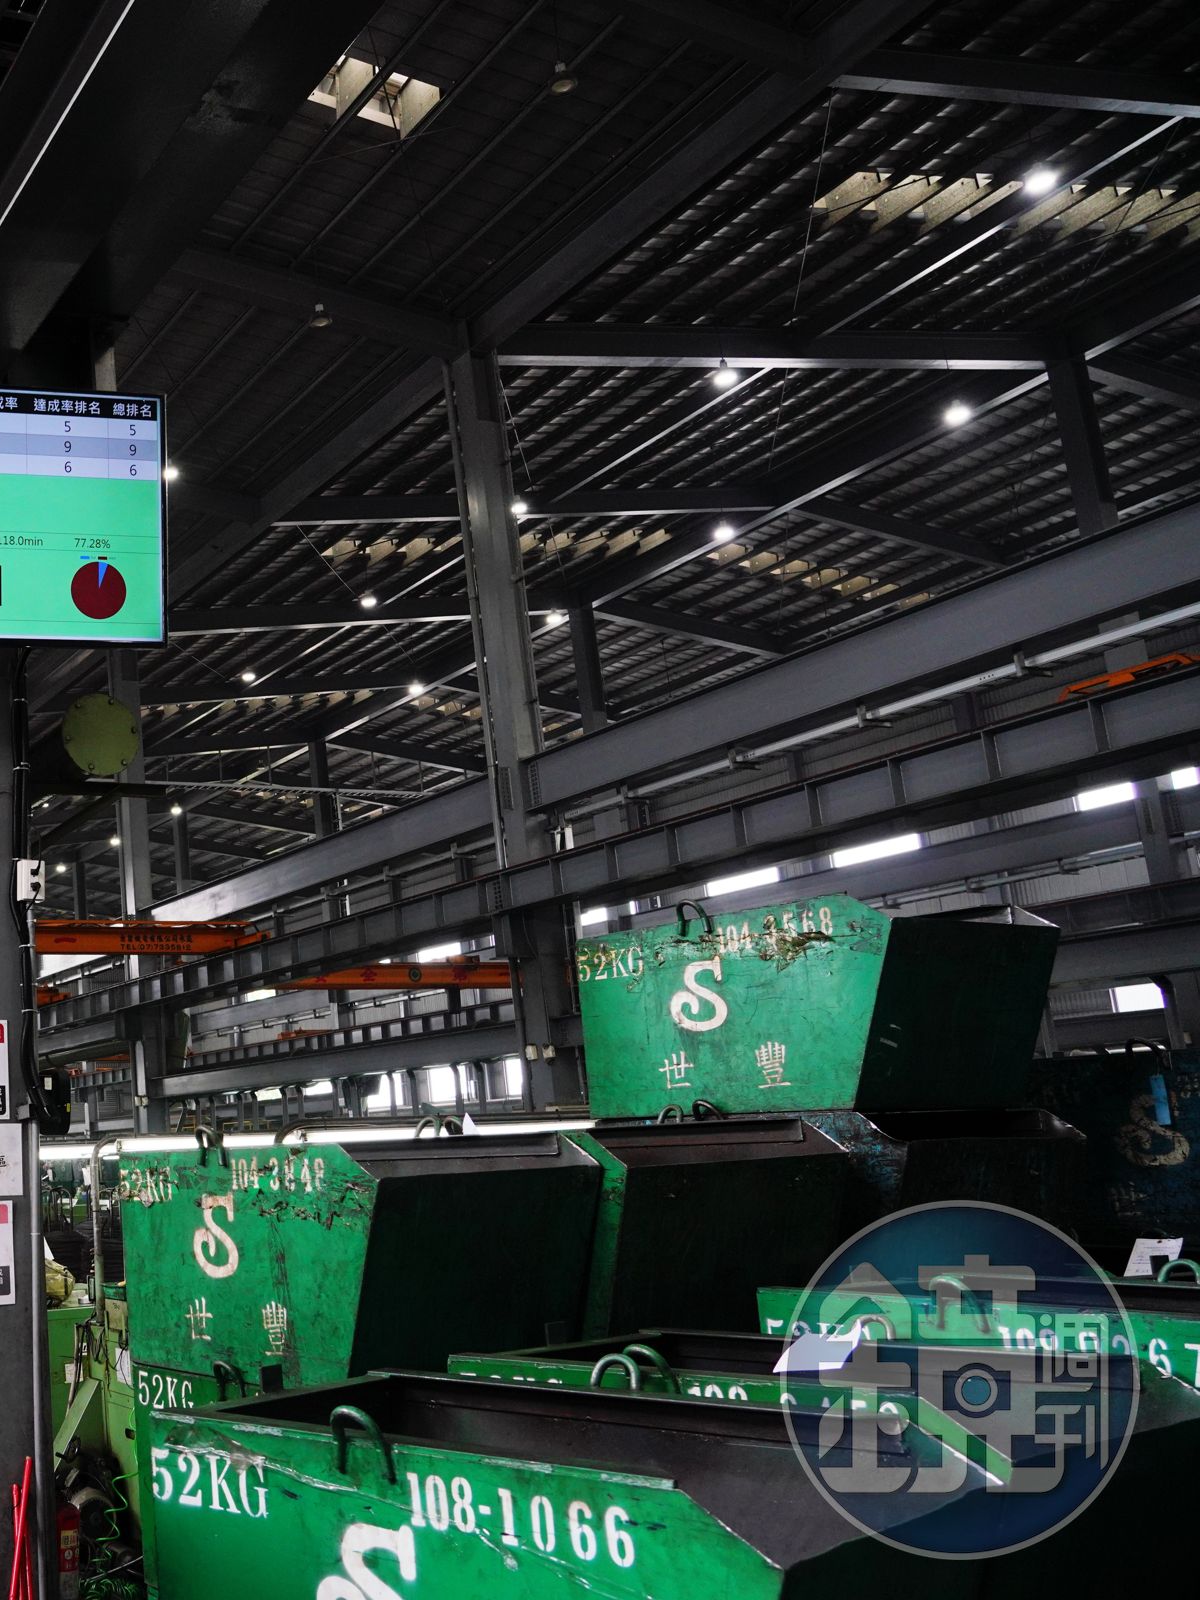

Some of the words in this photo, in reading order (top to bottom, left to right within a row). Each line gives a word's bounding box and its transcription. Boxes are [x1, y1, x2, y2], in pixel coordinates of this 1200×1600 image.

[33, 398, 101, 415] 達成率排名
[112, 402, 152, 418] 總排名
[64, 421, 71, 433] 5
[129, 424, 136, 436] 5
[64, 440, 72, 453] 9
[129, 444, 137, 456] 9
[64, 460, 72, 473] 6
[129, 464, 137, 476] 6
[74, 537, 111, 549] 77.28%
[576, 946, 643, 982] 52KG
[670, 955, 728, 1033] S
[192, 1192, 240, 1279] S
[138, 1370, 195, 1409] 52KG
[150, 1447, 269, 1518] 52KG
[407, 1472, 636, 1568] 108-1066
